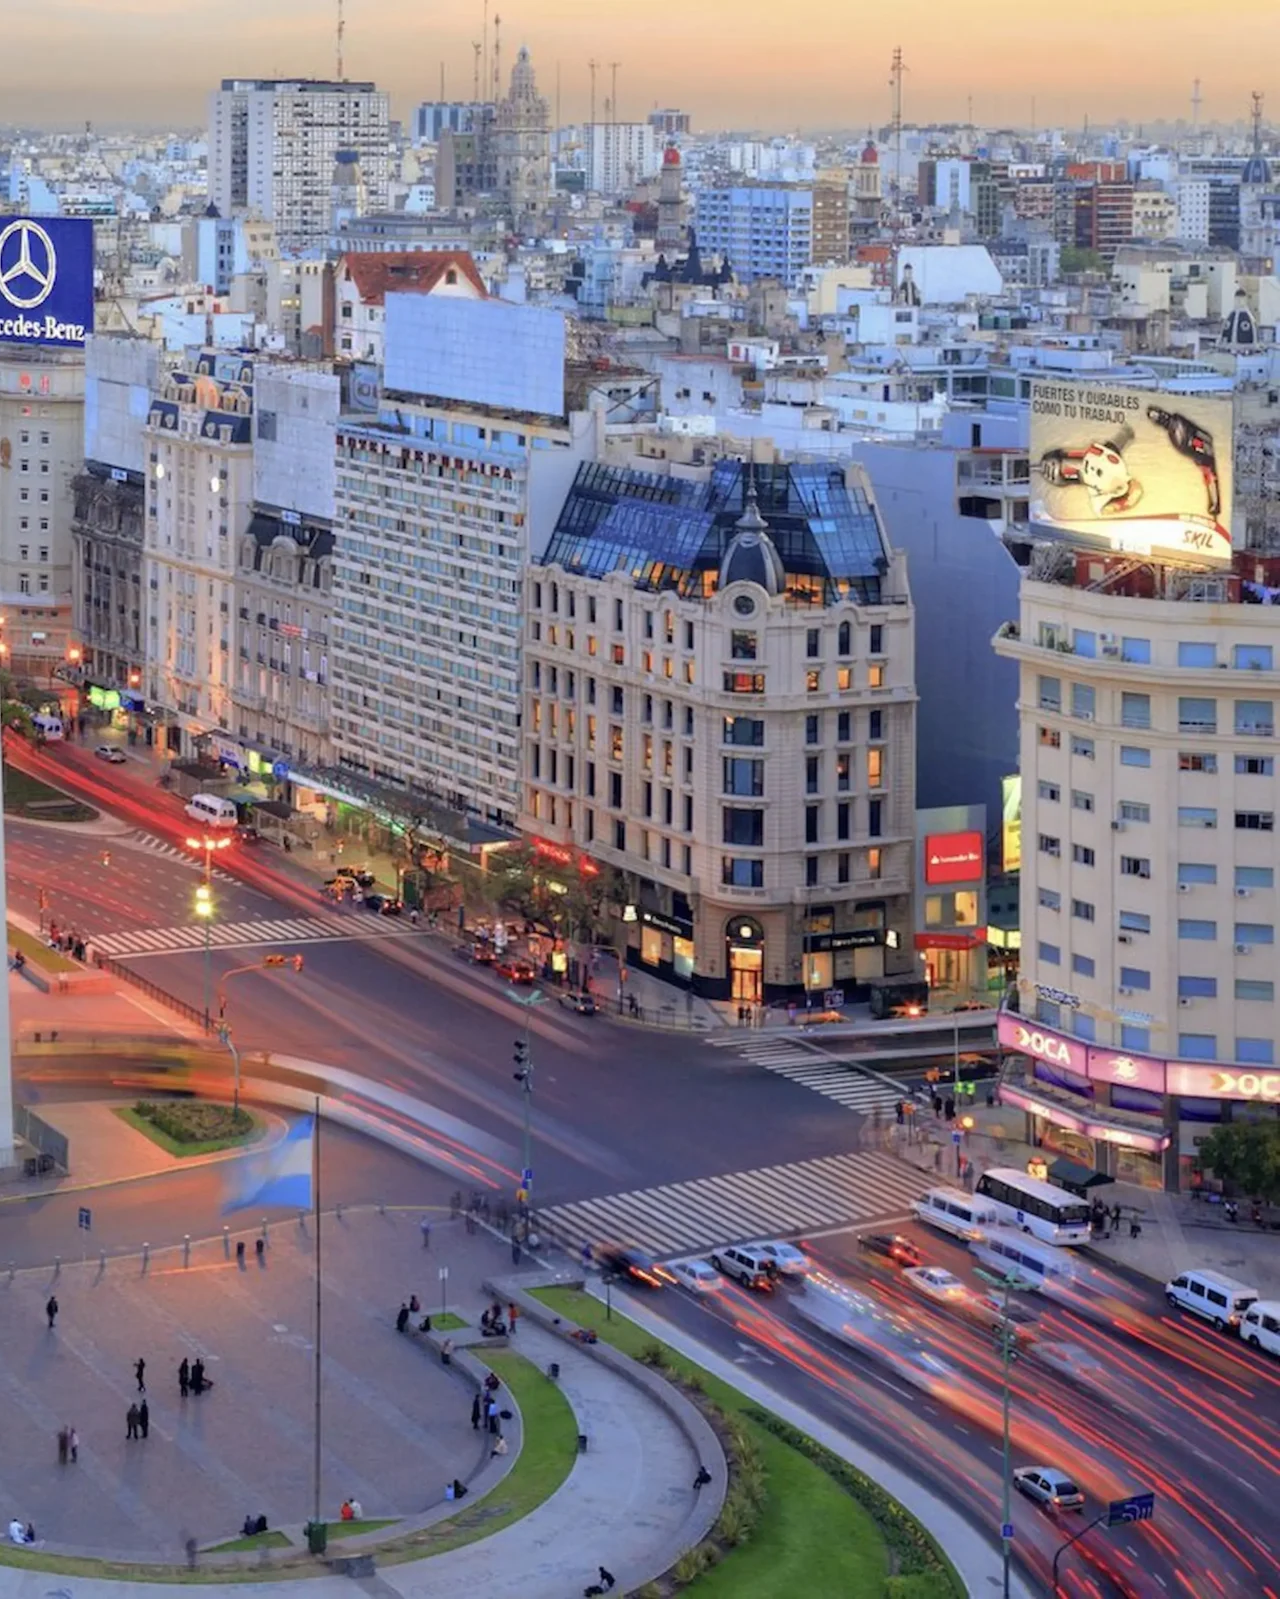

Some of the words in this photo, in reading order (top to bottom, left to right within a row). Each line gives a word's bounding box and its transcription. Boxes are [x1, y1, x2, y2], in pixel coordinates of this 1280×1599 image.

[1033, 384, 1075, 402] FUERTES
[1078, 391, 1085, 404] Y
[1087, 391, 1140, 410] DURABLES
[1033, 400, 1061, 416] COMO
[1064, 404, 1077, 419] TU
[1081, 406, 1125, 424] TRABAJO
[336, 434, 391, 456] HOTEL
[1183, 529, 1214, 550] SKIL
[1030, 1031, 1072, 1065] OCA
